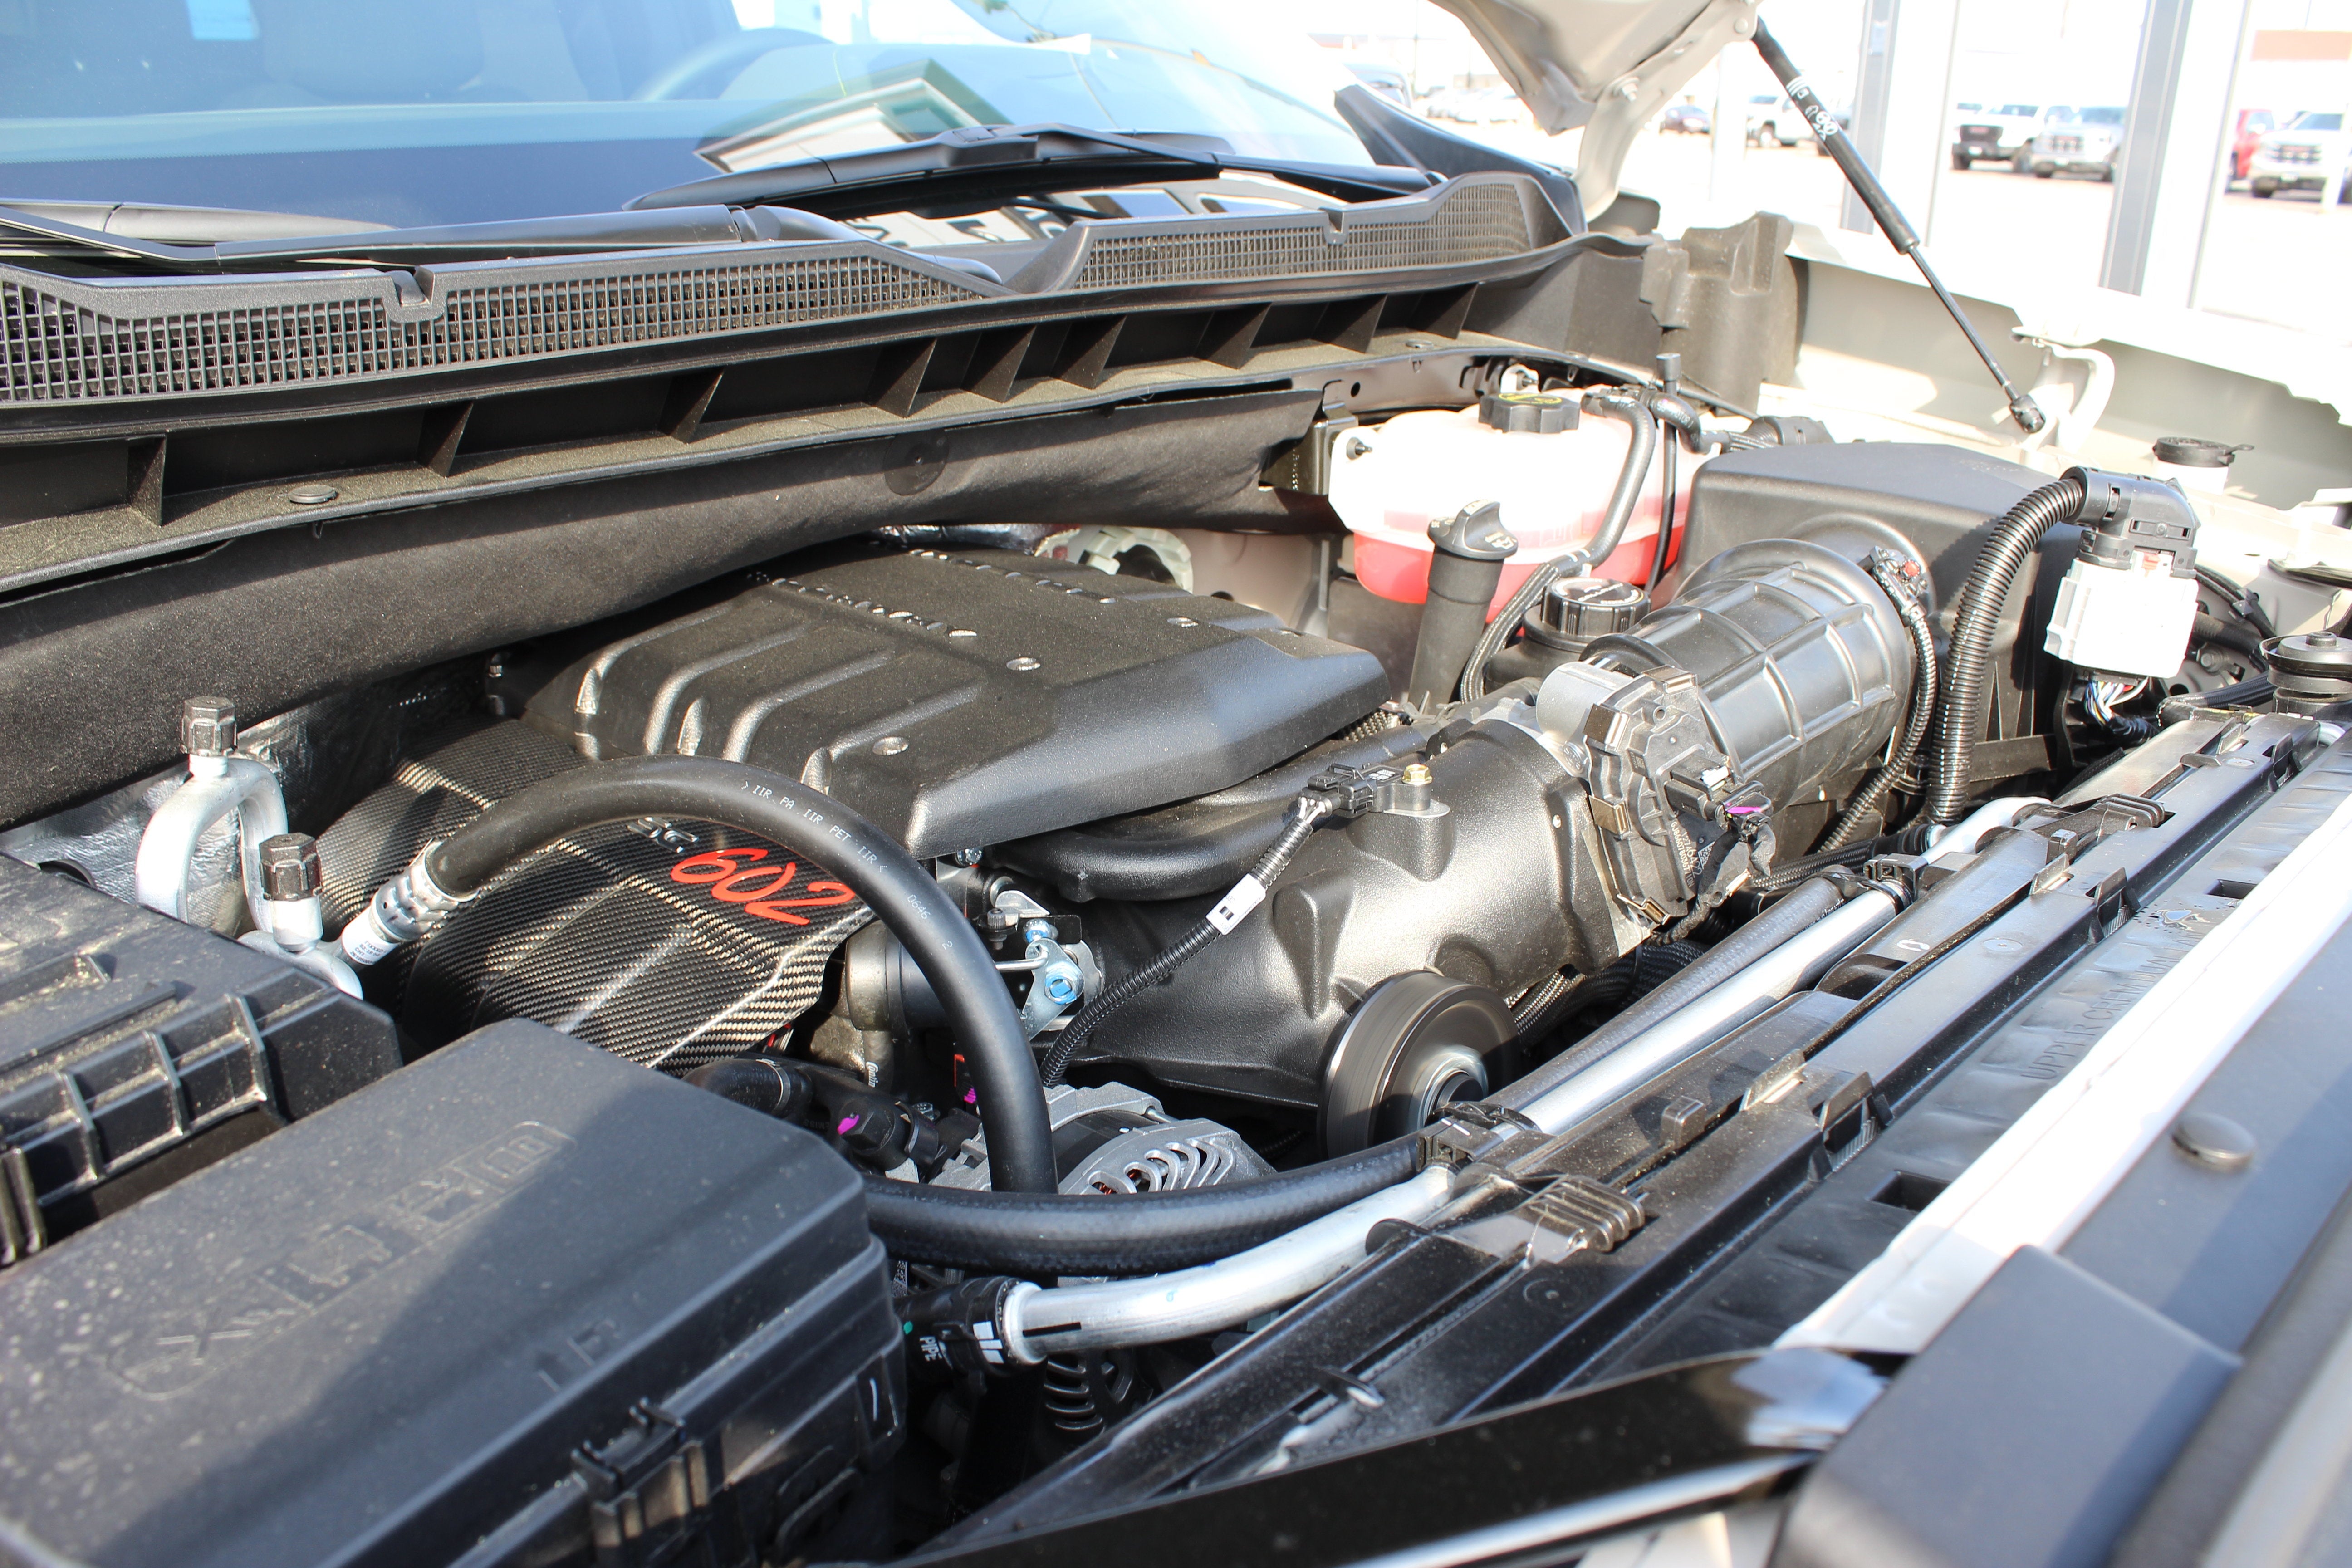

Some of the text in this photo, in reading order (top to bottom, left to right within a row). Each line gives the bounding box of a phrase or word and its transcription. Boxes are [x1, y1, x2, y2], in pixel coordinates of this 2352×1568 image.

[752, 784, 877, 864] IIR PA IIR PET IIR
[671, 848, 855, 926] 602
[907, 894, 931, 919] 0646
[919, 1336, 942, 1362] PIPE
